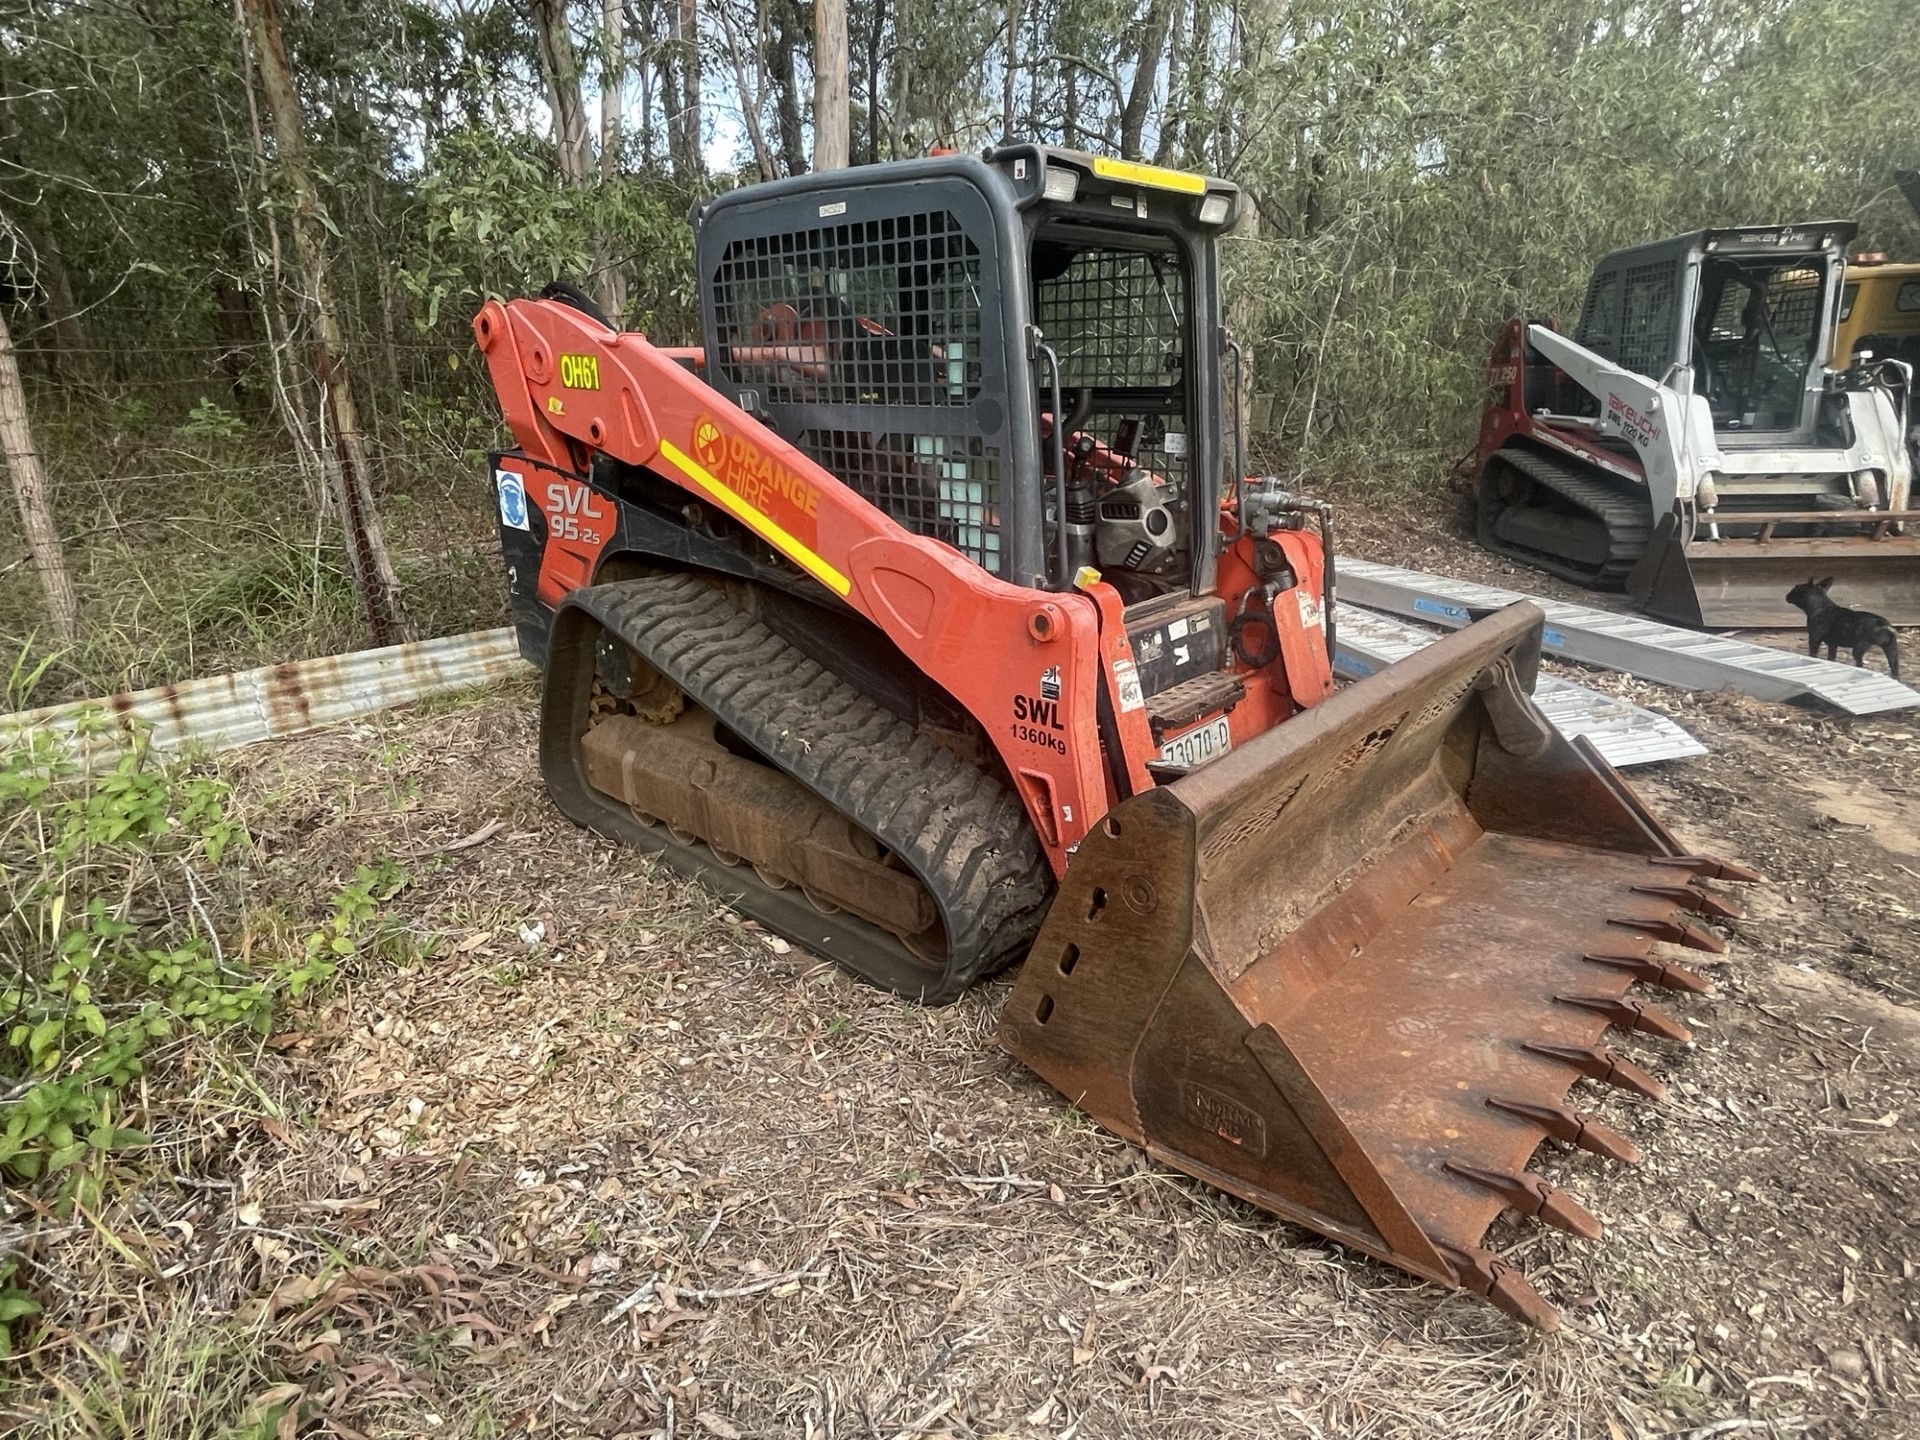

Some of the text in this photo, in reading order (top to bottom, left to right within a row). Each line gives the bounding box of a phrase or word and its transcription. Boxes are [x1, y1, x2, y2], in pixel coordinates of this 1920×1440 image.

[1739, 233, 1805, 243] TAKEUHI
[561, 355, 600, 390] OH61
[1607, 409, 1622, 427] SWL
[1621, 421, 1638, 438] 1120
[1637, 432, 1650, 448] KG
[1608, 391, 1661, 441] TAKEUCHI
[727, 460, 773, 516] HIRE
[730, 433, 820, 520] ORANGE
[546, 483, 603, 519] SVL
[1013, 694, 1064, 731] SWL
[1010, 723, 1066, 756] 1360kg
